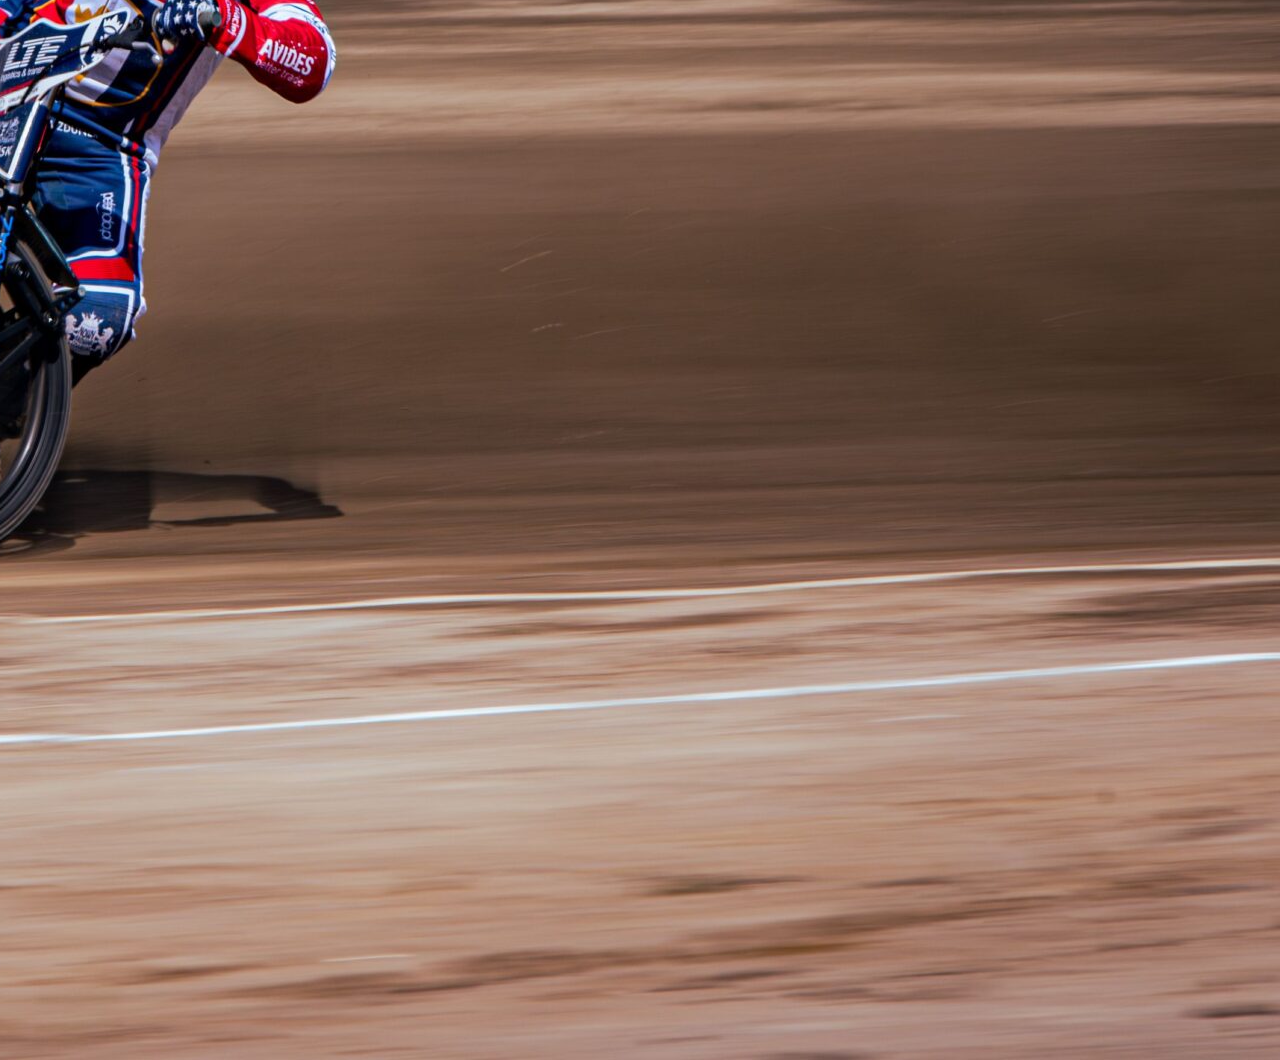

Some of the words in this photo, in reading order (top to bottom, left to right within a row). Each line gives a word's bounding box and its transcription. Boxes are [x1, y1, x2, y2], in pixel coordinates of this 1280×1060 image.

[3, 35, 67, 71] LTE
[259, 38, 315, 76] AVIDES
[255, 58, 281, 75] better
[280, 69, 305, 87] trade
